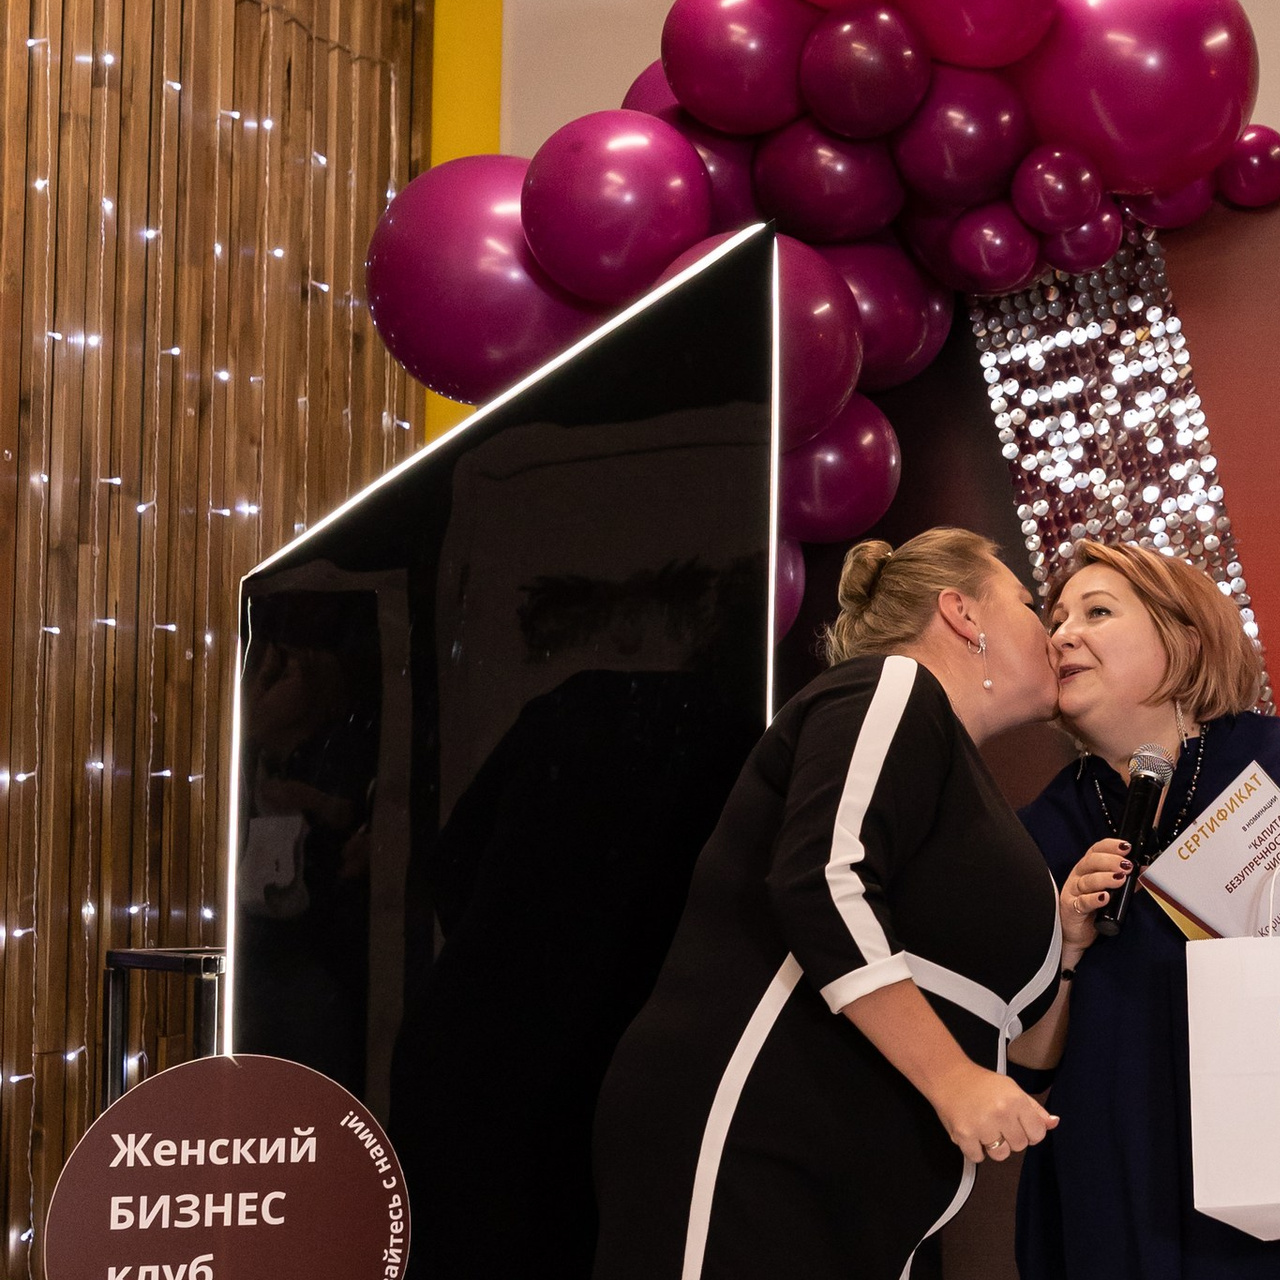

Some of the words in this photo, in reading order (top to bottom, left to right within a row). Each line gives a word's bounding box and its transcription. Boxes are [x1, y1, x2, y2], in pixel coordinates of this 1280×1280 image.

[1177, 773, 1262, 860] СЕРТИФИКАТ
[1246, 795, 1278, 828] НОМИНАЦИИ
[109, 1127, 317, 1167] Женский
[340, 1111, 392, 1174] нами!
[382, 1176, 397, 1189] с
[109, 1191, 287, 1231] БИЗНЕС
